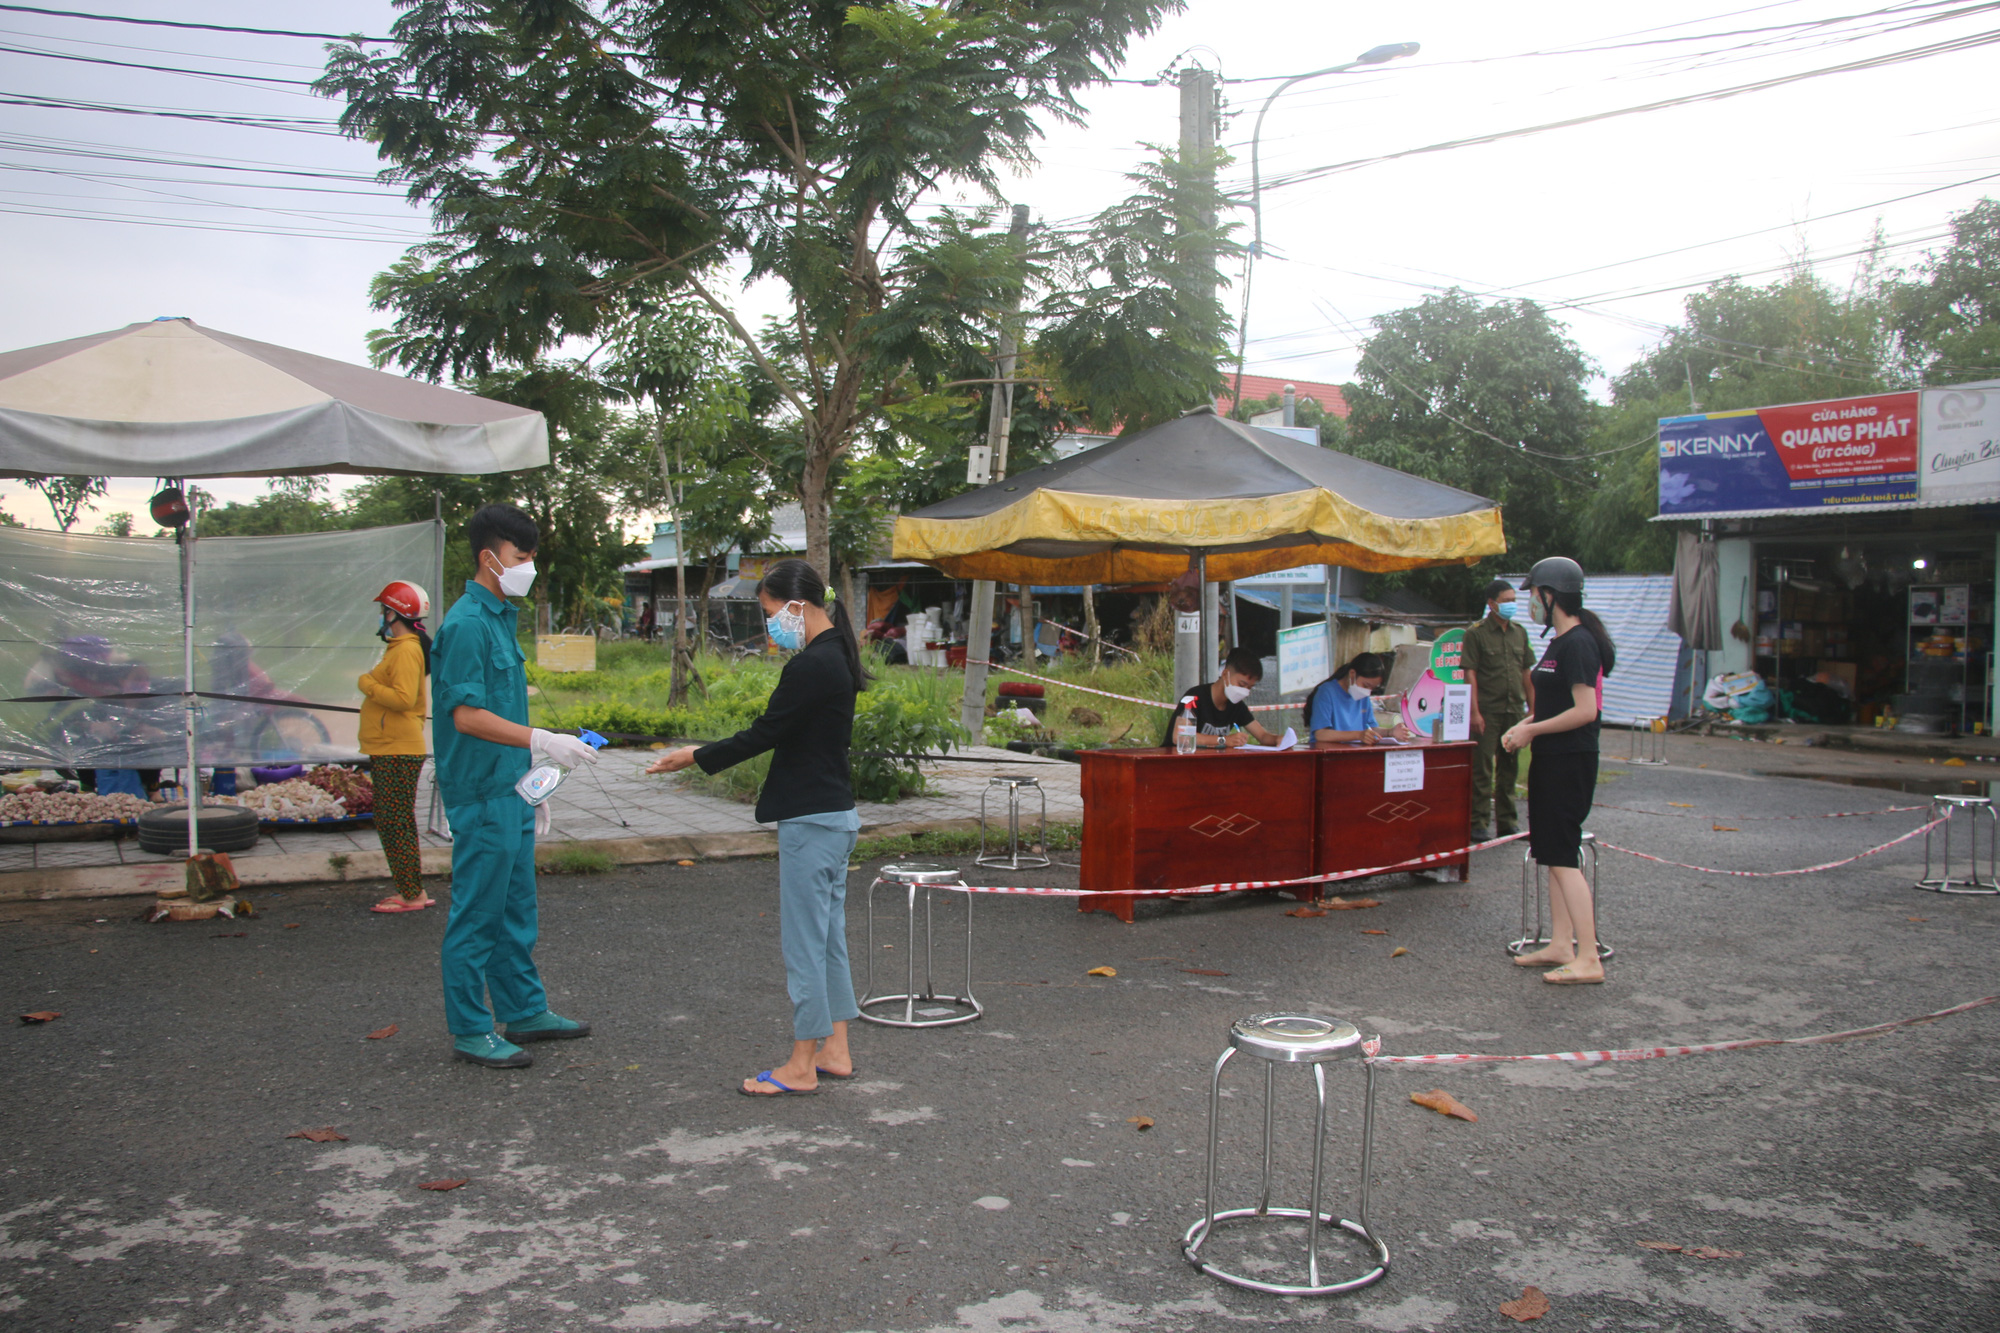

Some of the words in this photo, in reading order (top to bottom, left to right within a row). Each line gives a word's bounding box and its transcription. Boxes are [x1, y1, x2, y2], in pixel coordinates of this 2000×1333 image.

[1811, 408, 1838, 422] CỬA
[1840, 406, 1877, 420] HÀNG
[1781, 424, 1852, 449] QUANG
[1855, 414, 1911, 440] PHÁT
[1677, 432, 1760, 456] KENNY
[1812, 446, 1833, 461] (ÚT
[1834, 442, 1876, 458] CÔNG)
[1931, 449, 1975, 472] Chuyên
[1979, 439, 2000, 458] Bá
[1445, 654, 1461, 667] PHÒN
[1452, 669, 1464, 680] COV
